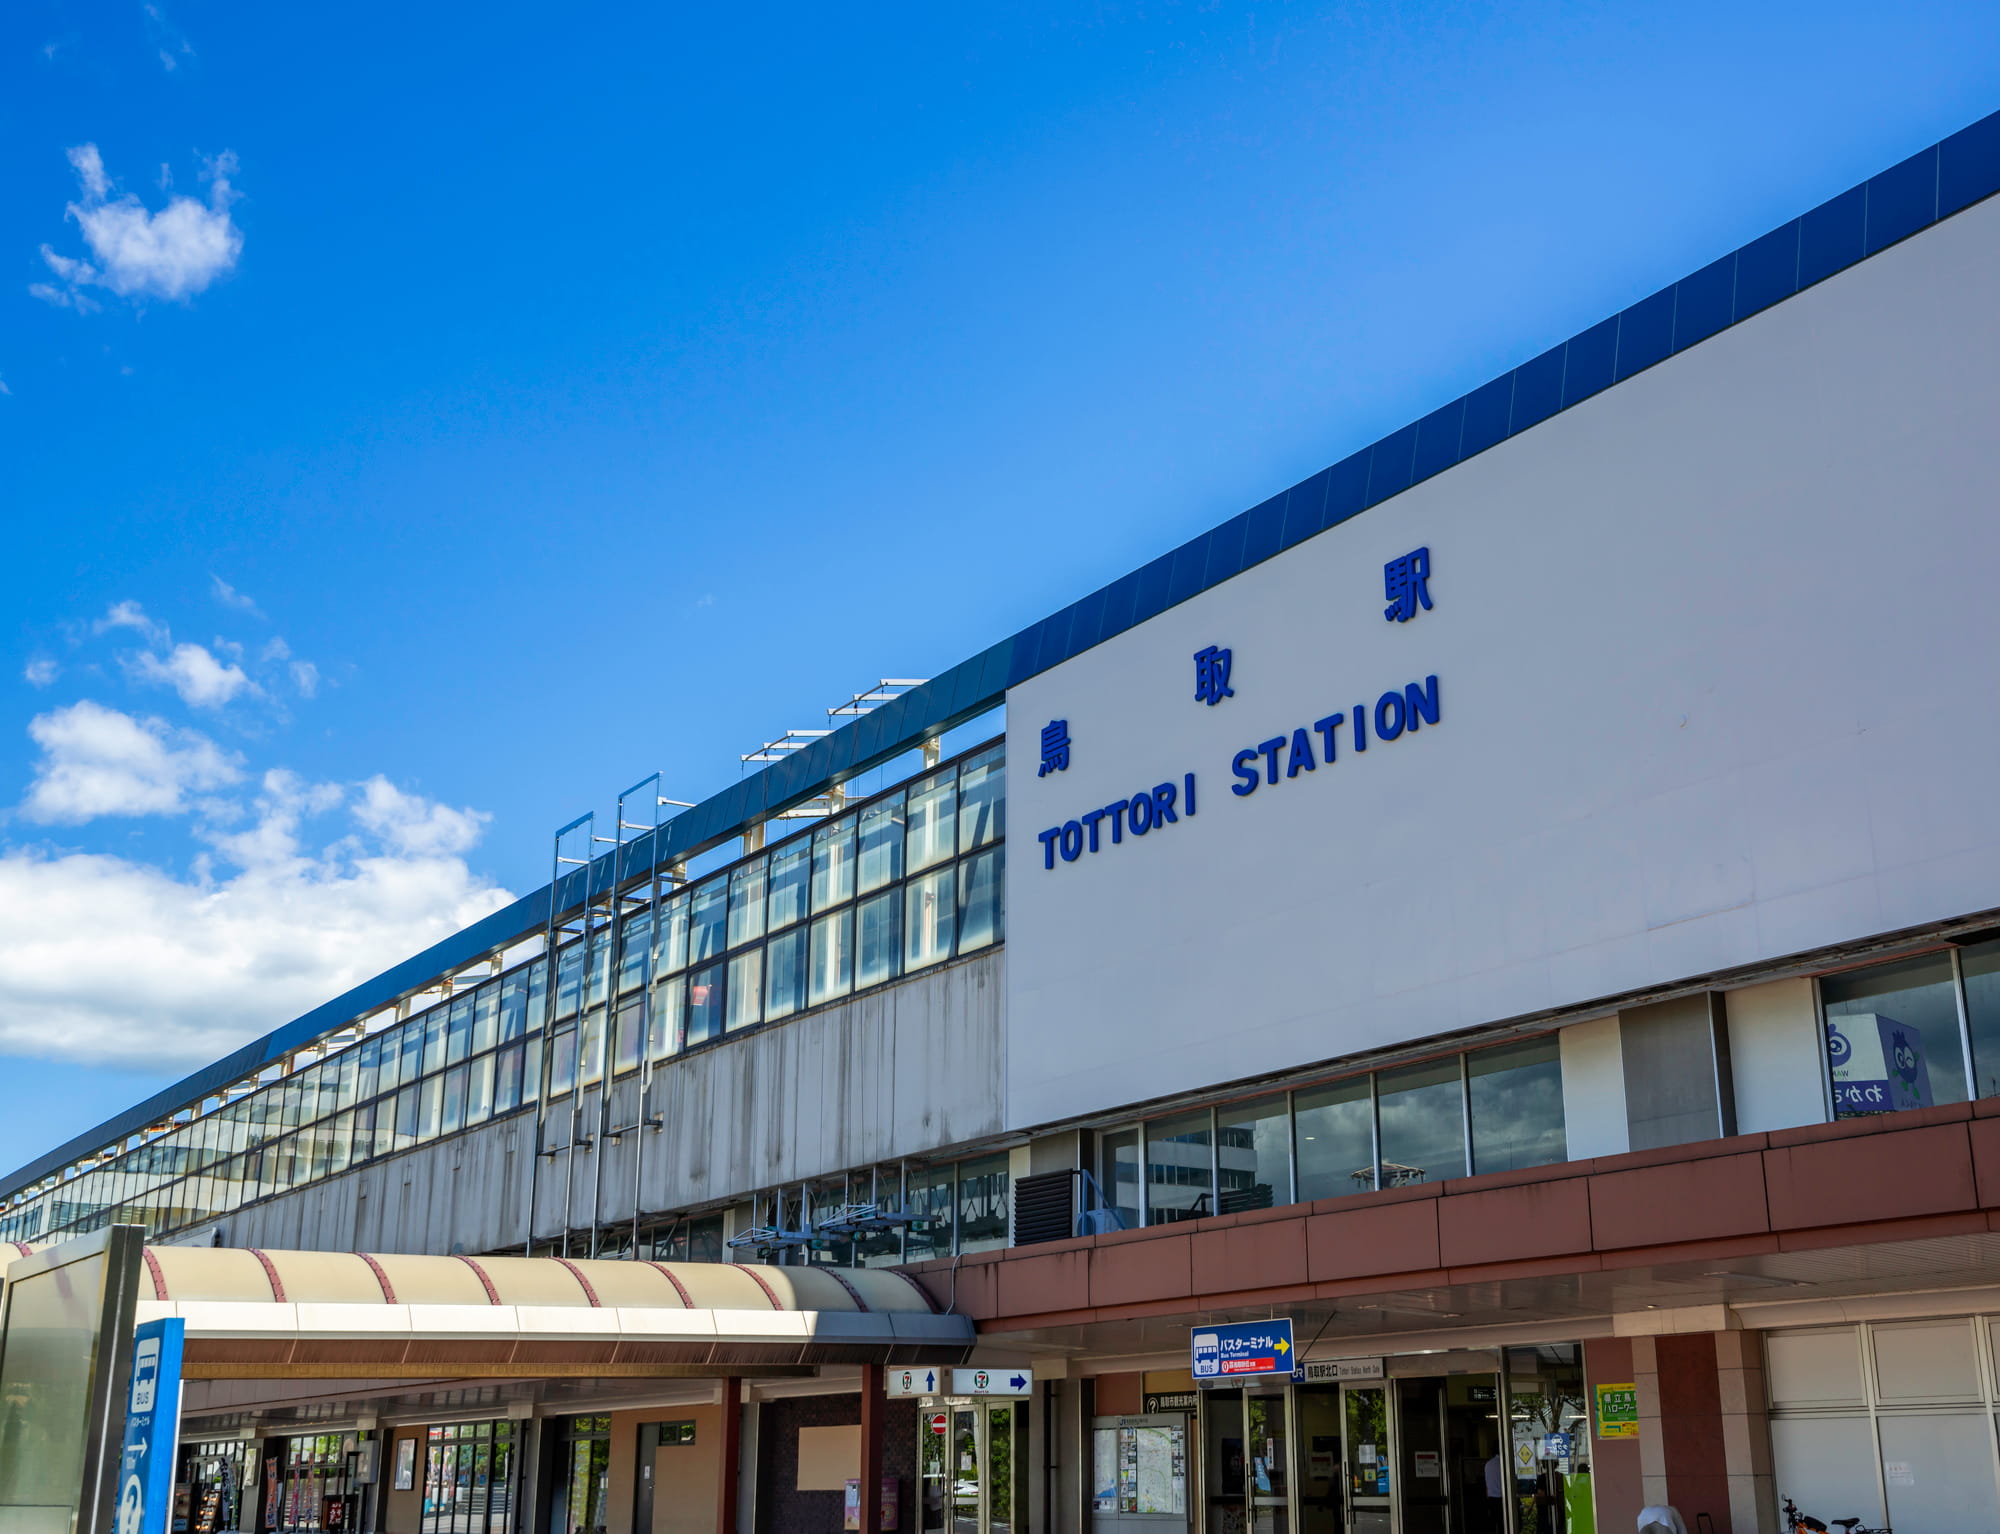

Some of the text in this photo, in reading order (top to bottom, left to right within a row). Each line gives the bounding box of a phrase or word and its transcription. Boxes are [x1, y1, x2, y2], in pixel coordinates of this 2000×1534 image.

[1038, 675, 1440, 870] TOTTORI STATION
[1220, 1336, 1274, 1351] バスターミナル
[1220, 1351, 1230, 1359] Bus
[1200, 1364, 1213, 1374] BUS
[136, 1391, 150, 1405] BUS
